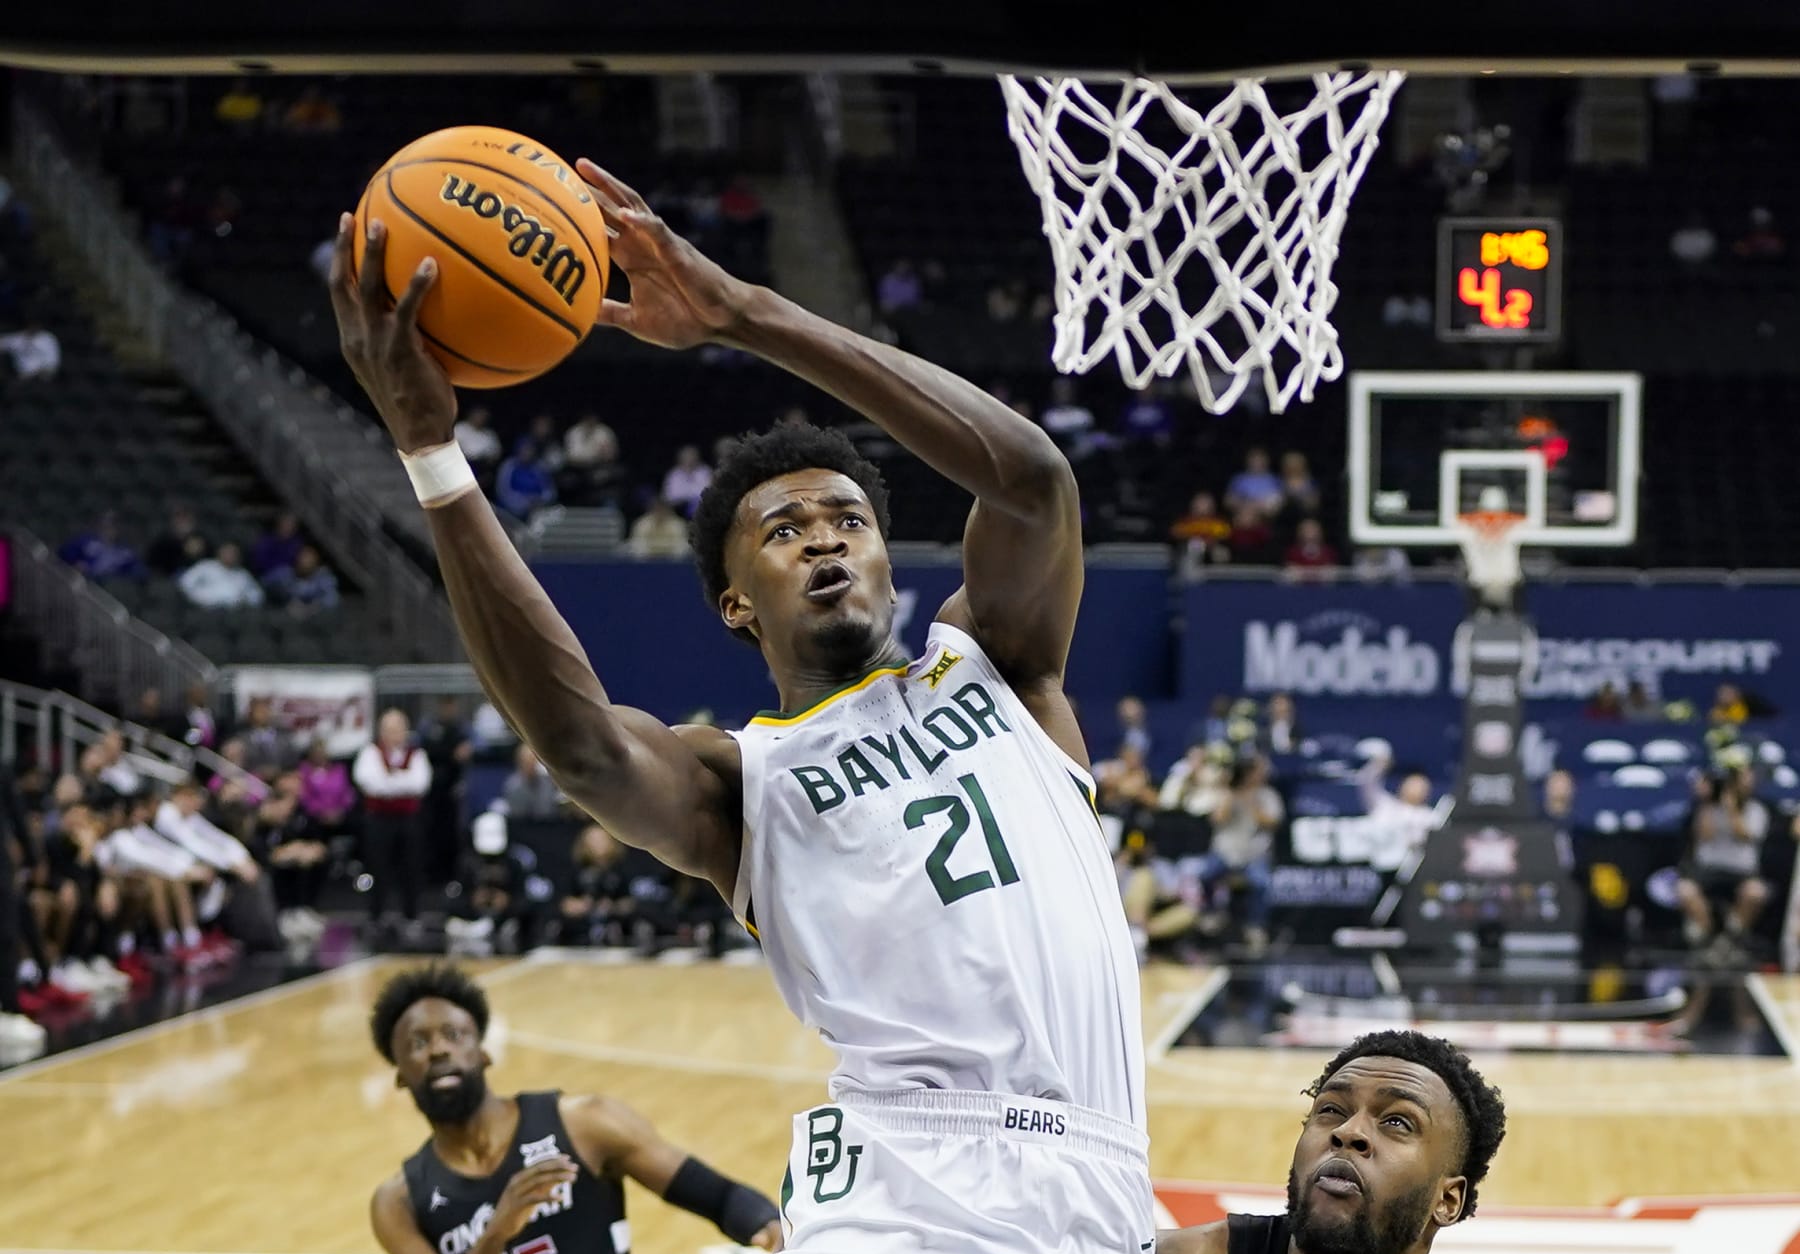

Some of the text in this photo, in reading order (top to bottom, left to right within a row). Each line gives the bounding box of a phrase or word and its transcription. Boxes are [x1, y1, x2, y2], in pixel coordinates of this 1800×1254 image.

[441, 173, 587, 308] Wilson
[1243, 621, 1440, 696] Modelo
[789, 682, 1012, 815] BAYLOR
[903, 773, 1020, 906] 21
[806, 1107, 864, 1204] BU
[1004, 1107, 1066, 1136] BEARS
